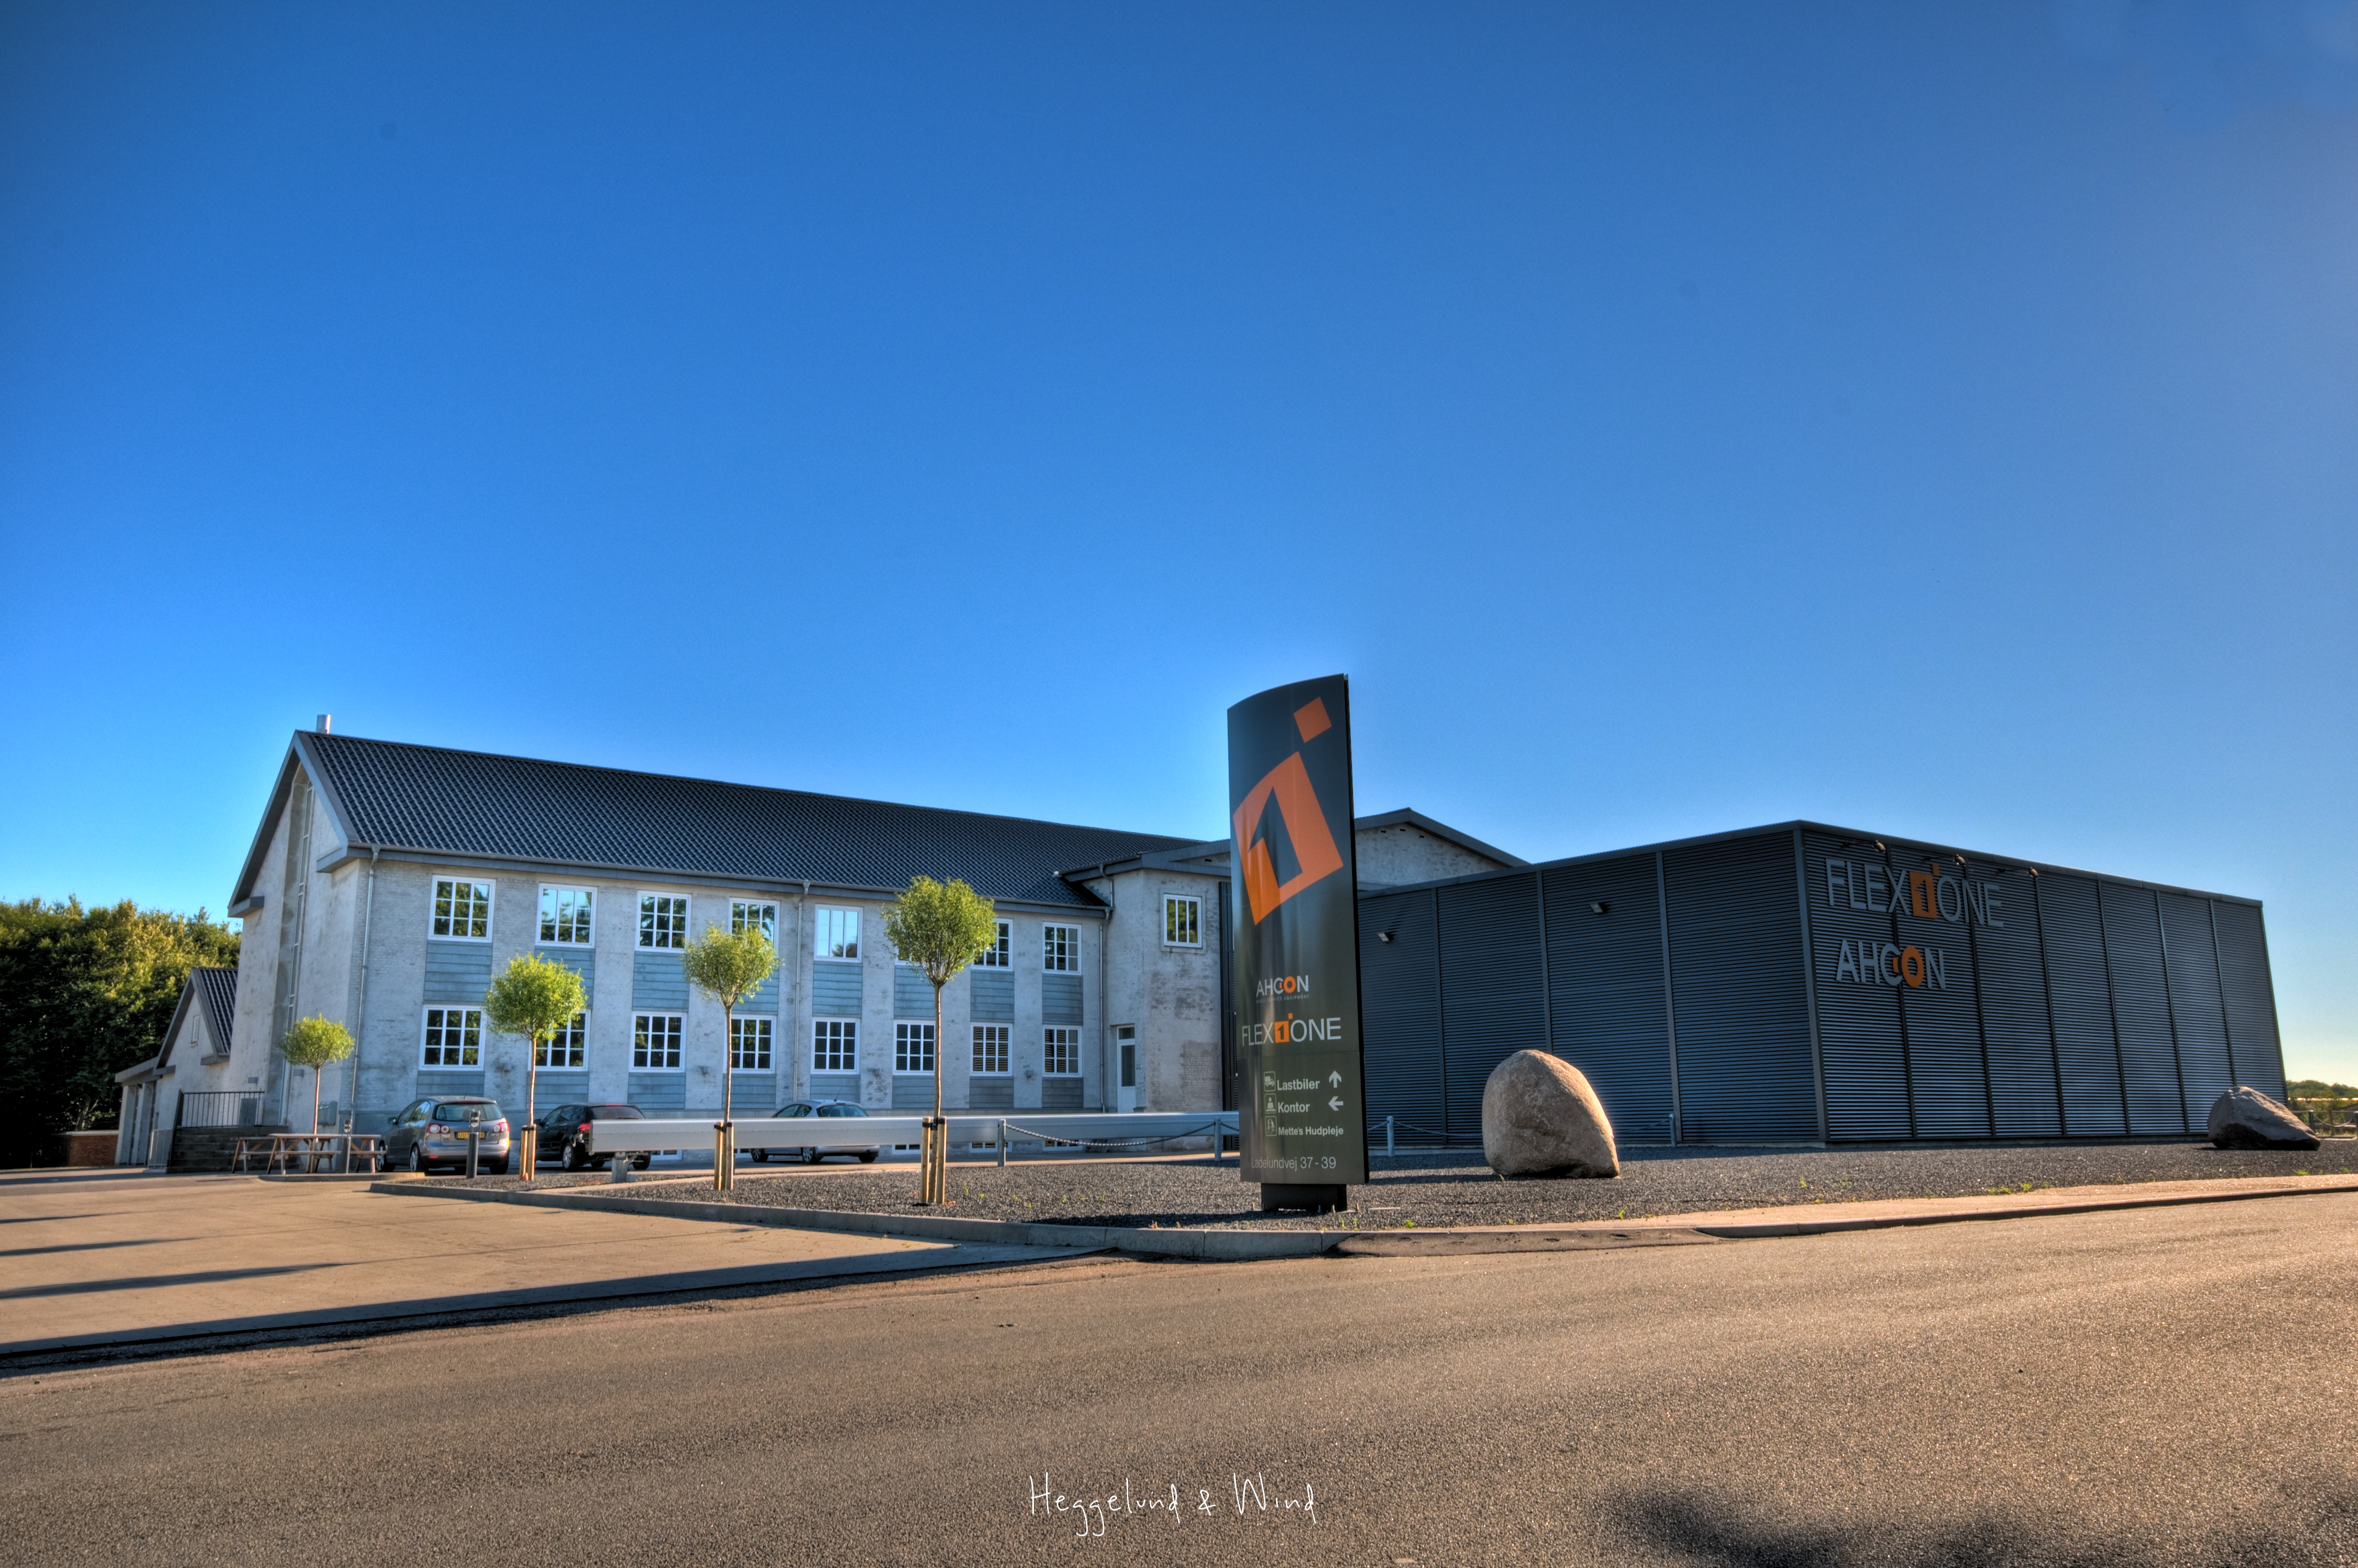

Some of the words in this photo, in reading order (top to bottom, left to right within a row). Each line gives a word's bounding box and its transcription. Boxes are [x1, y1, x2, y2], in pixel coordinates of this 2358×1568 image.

[1836, 939, 1946, 989] AHCON
[1256, 975, 1309, 997] AHCON
[1277, 1079, 1320, 1091] Lastbiler
[1278, 1102, 1310, 1113] Kontor
[1305, 1126, 1344, 1137] Hudpleje
[1251, 1157, 1297, 1172] Ladelundvej
[1300, 1157, 1313, 1169] 37
[1321, 1156, 1336, 1169] 39
